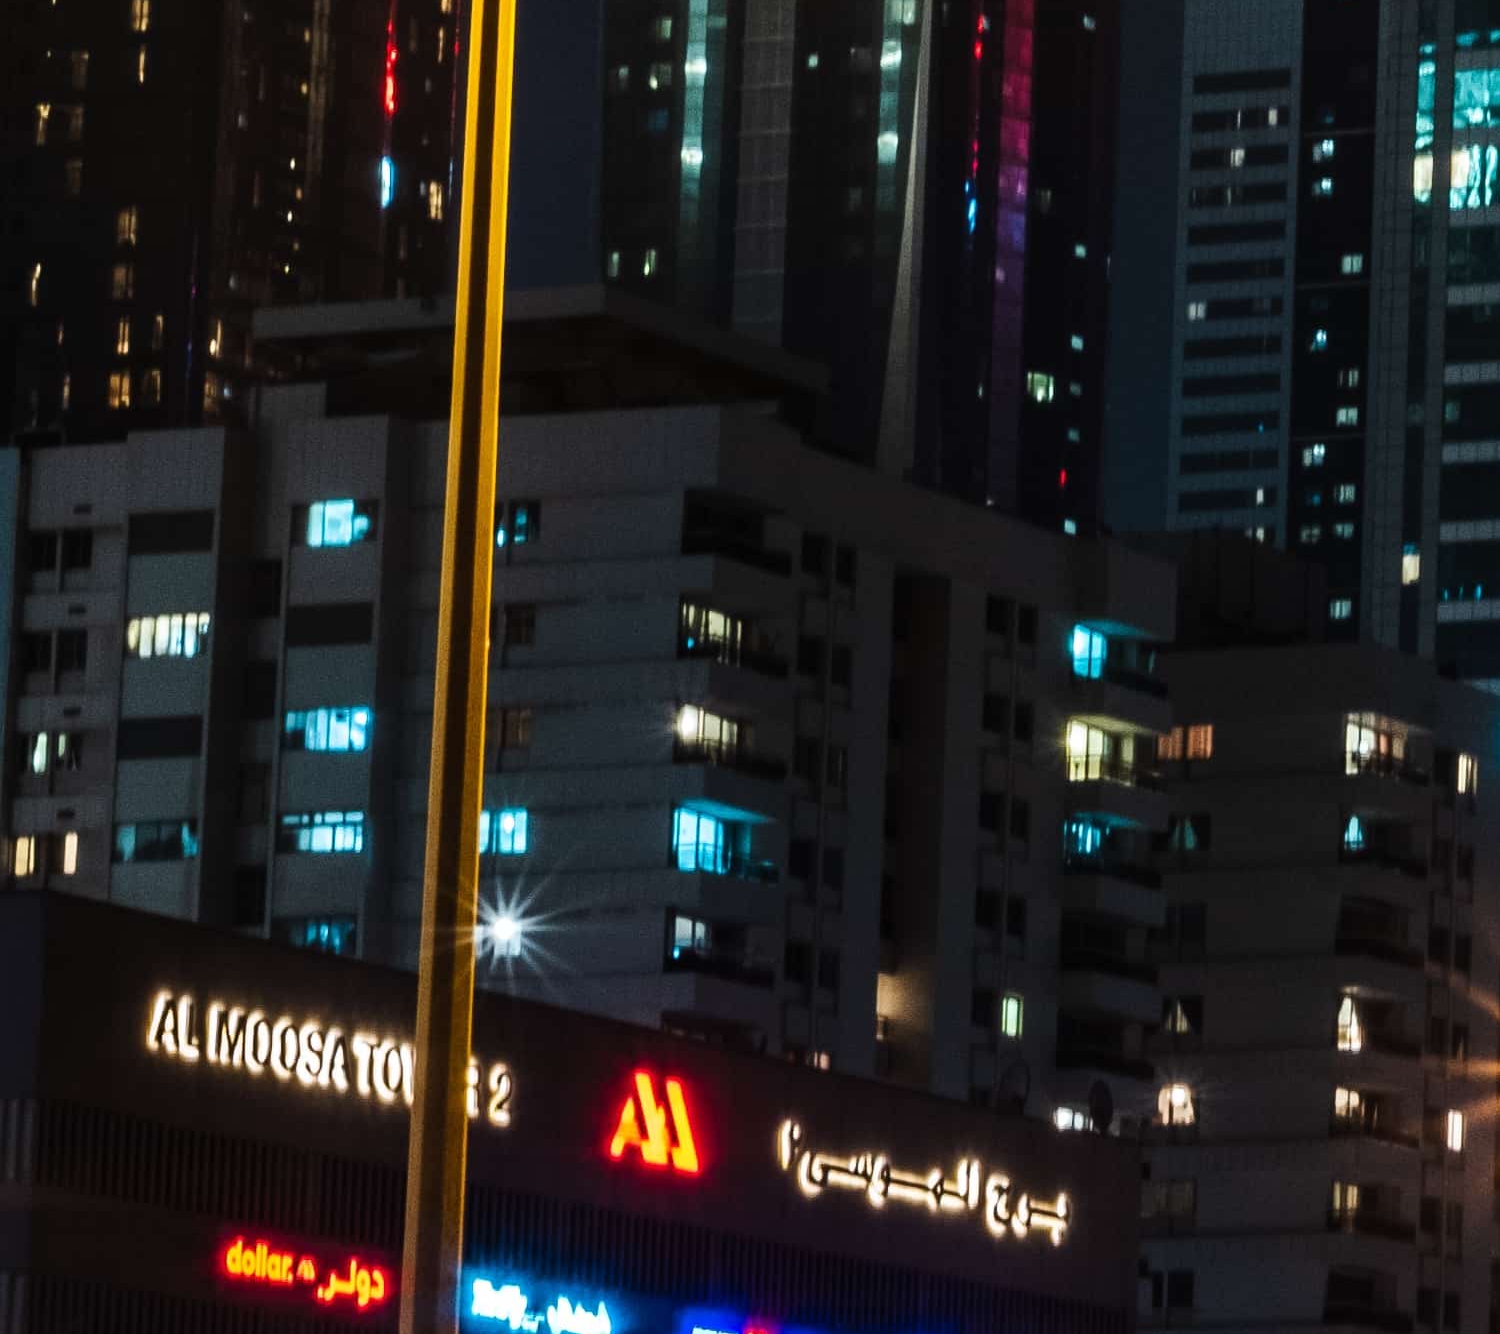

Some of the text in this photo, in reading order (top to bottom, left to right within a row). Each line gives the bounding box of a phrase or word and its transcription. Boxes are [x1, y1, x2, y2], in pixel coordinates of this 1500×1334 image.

[147, 989, 200, 1062] AL
[206, 1001, 349, 1094] MOOSA
[488, 1062, 513, 1128] 2
